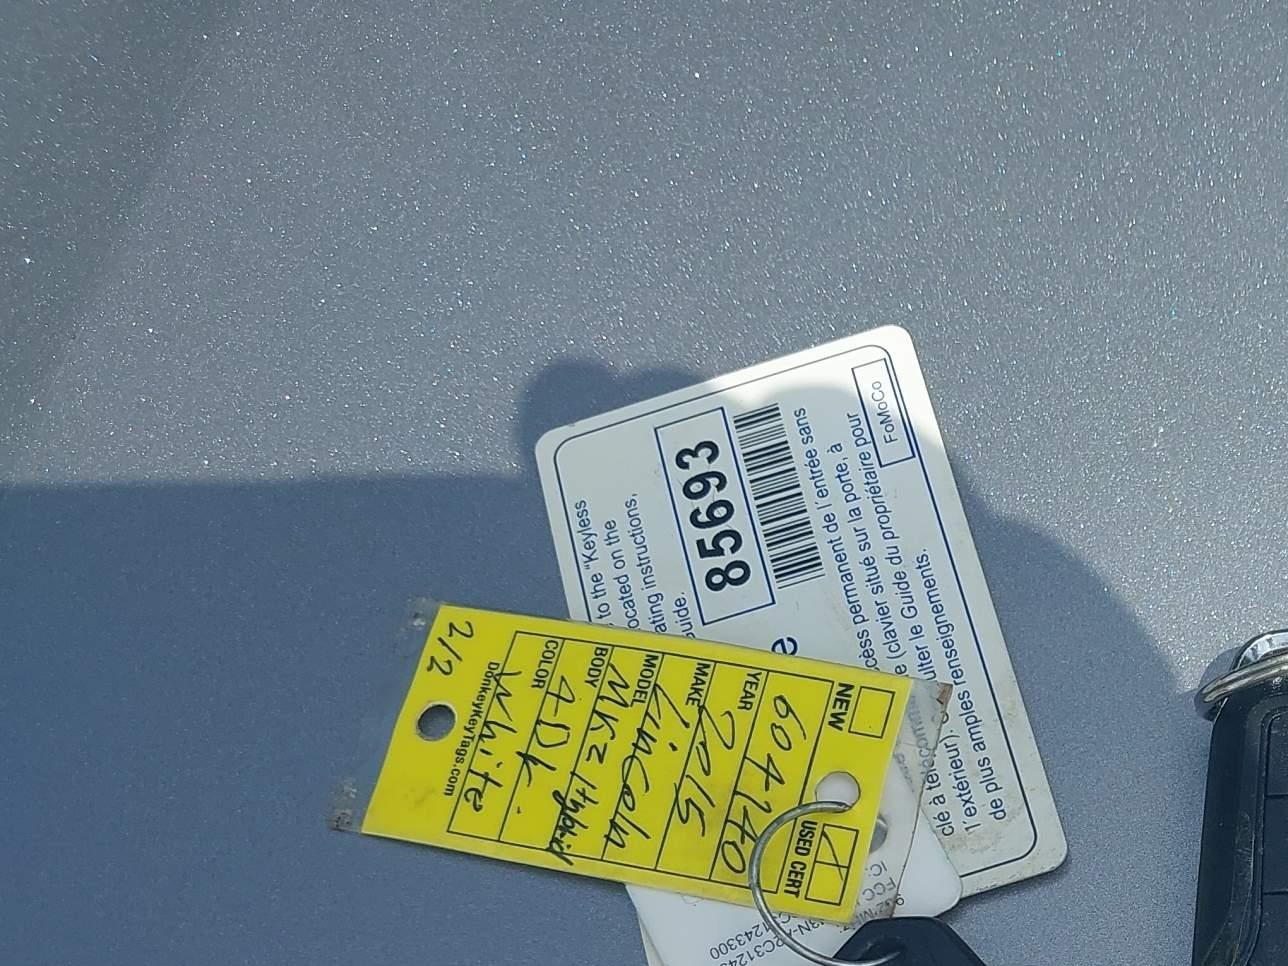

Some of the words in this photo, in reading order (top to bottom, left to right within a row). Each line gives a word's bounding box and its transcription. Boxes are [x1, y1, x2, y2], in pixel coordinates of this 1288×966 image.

[793, 407, 814, 445] sans
[846, 407, 872, 448] pour
[870, 379, 900, 445] FoMoCo
[826, 442, 843, 454] à
[834, 457, 862, 504] porte,
[858, 448, 900, 541] propriétaire
[603, 519, 621, 547] the
[674, 440, 752, 592] 85693
[821, 512, 839, 533] de
[847, 506, 863, 524] la
[610, 548, 626, 570] on
[624, 493, 657, 591] instructions,
[852, 526, 872, 552] sur
[884, 545, 903, 566] du
[590, 572, 607, 600] the
[826, 535, 870, 626] permanent
[858, 555, 884, 596] situé
[891, 570, 918, 620] Guide
[595, 602, 612, 620] to
[611, 572, 644, 633] ocated
[915, 548, 967, 690] renseignements.
[874, 600, 907, 660] (clavier
[908, 624, 925, 642] le
[530, 639, 559, 694] COLOR
[584, 646, 609, 689] BODY
[629, 651, 659, 711] MODEL
[685, 660, 711, 709] MAKE
[737, 671, 763, 711] YEAR
[827, 682, 855, 732] NEW
[444, 658, 500, 798] DonkeyKeyTags.com
[957, 689, 987, 753] amples
[673, 705, 738, 839] 2015
[977, 756, 1003, 794] plus
[928, 793, 946, 806] à
[988, 797, 1007, 821] de
[794, 820, 819, 857] USED
[932, 810, 955, 837] clé
[783, 860, 807, 899] CERT
